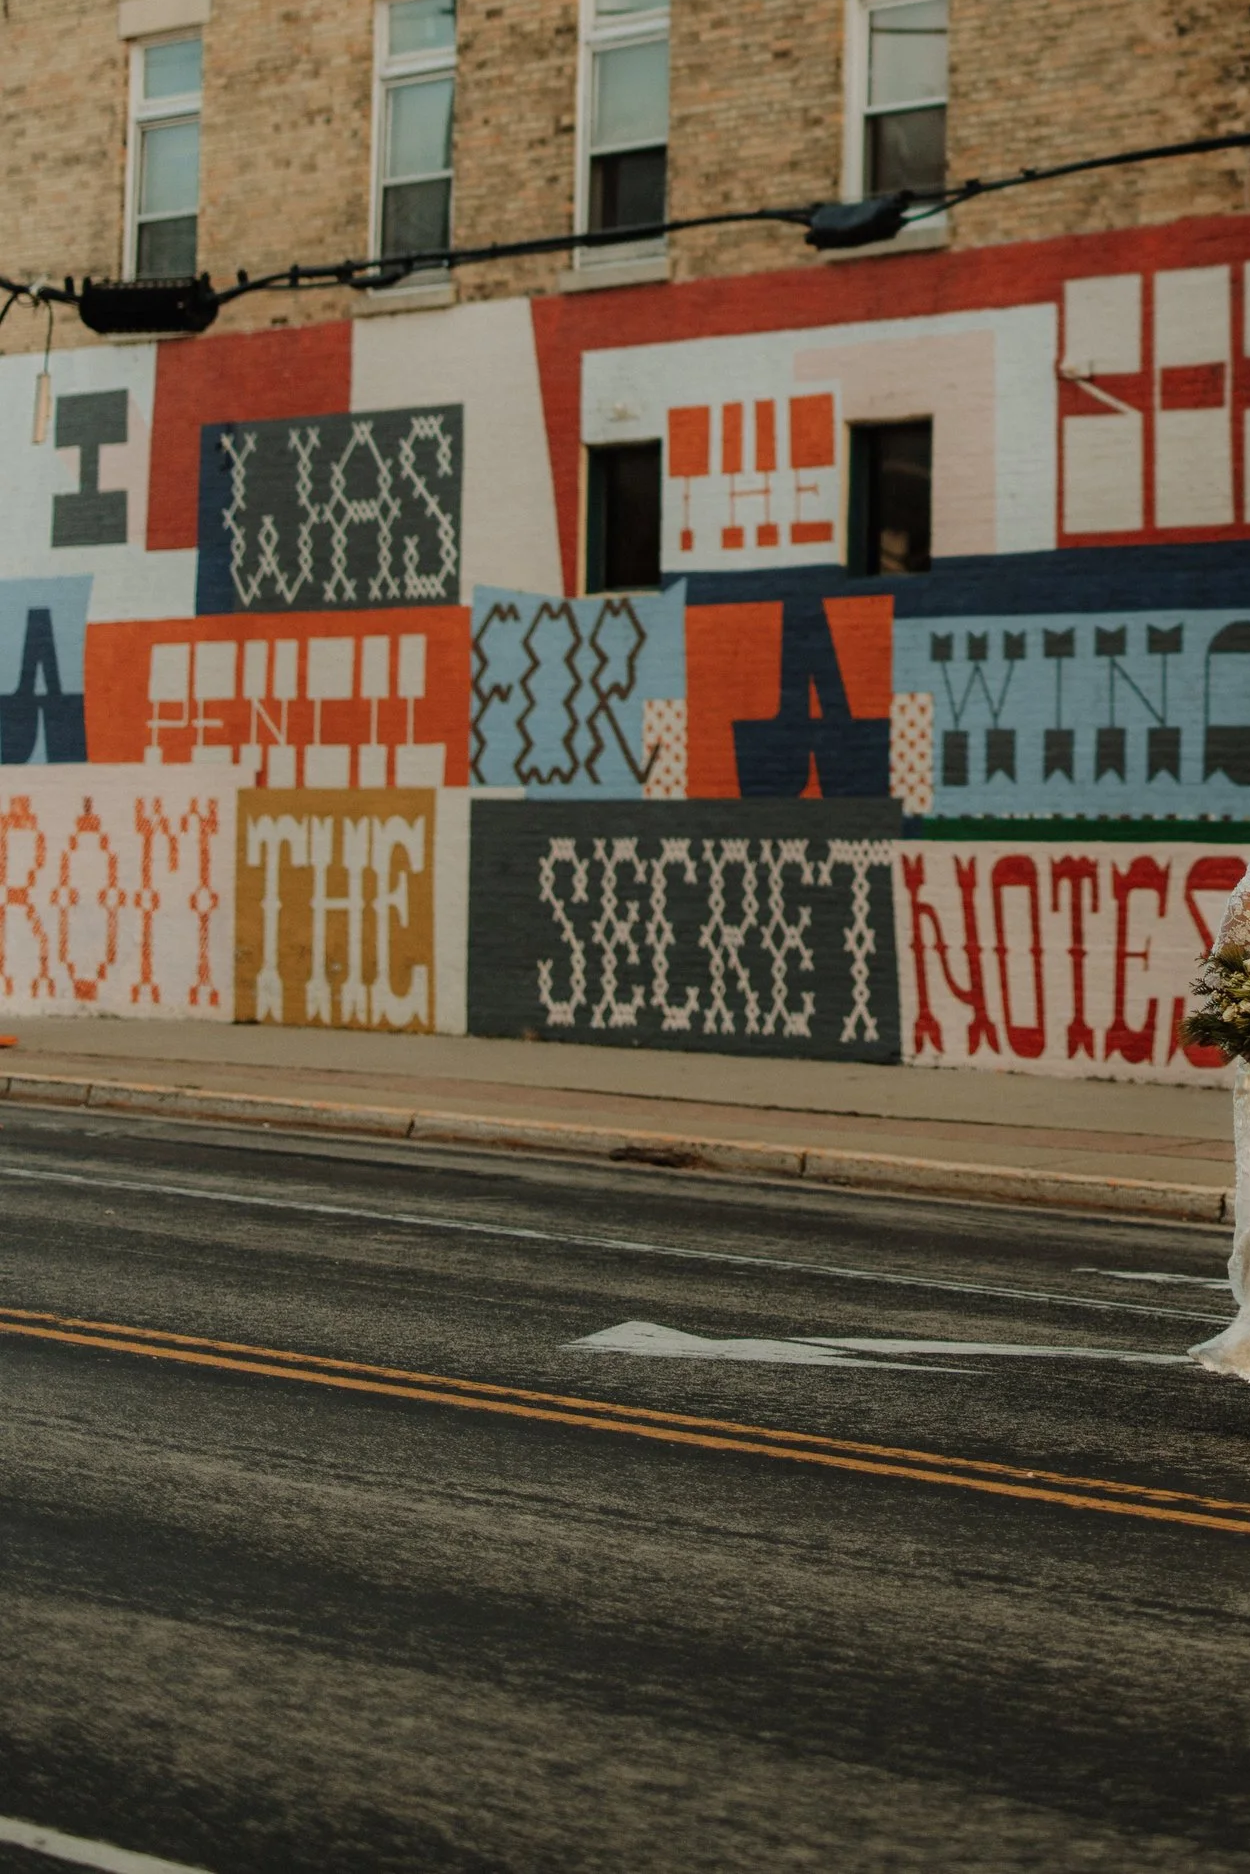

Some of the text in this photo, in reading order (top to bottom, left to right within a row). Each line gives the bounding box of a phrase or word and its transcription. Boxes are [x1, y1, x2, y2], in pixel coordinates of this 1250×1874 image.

[51, 388, 129, 548] I
[219, 414, 460, 606] WAS
[667, 392, 837, 551] THE
[0, 608, 88, 764] A
[143, 633, 446, 788] PENCIL
[470, 598, 661, 786] FOR
[732, 600, 893, 798] A
[246, 814, 429, 1026] THE
[537, 837, 894, 1043] SECRET
